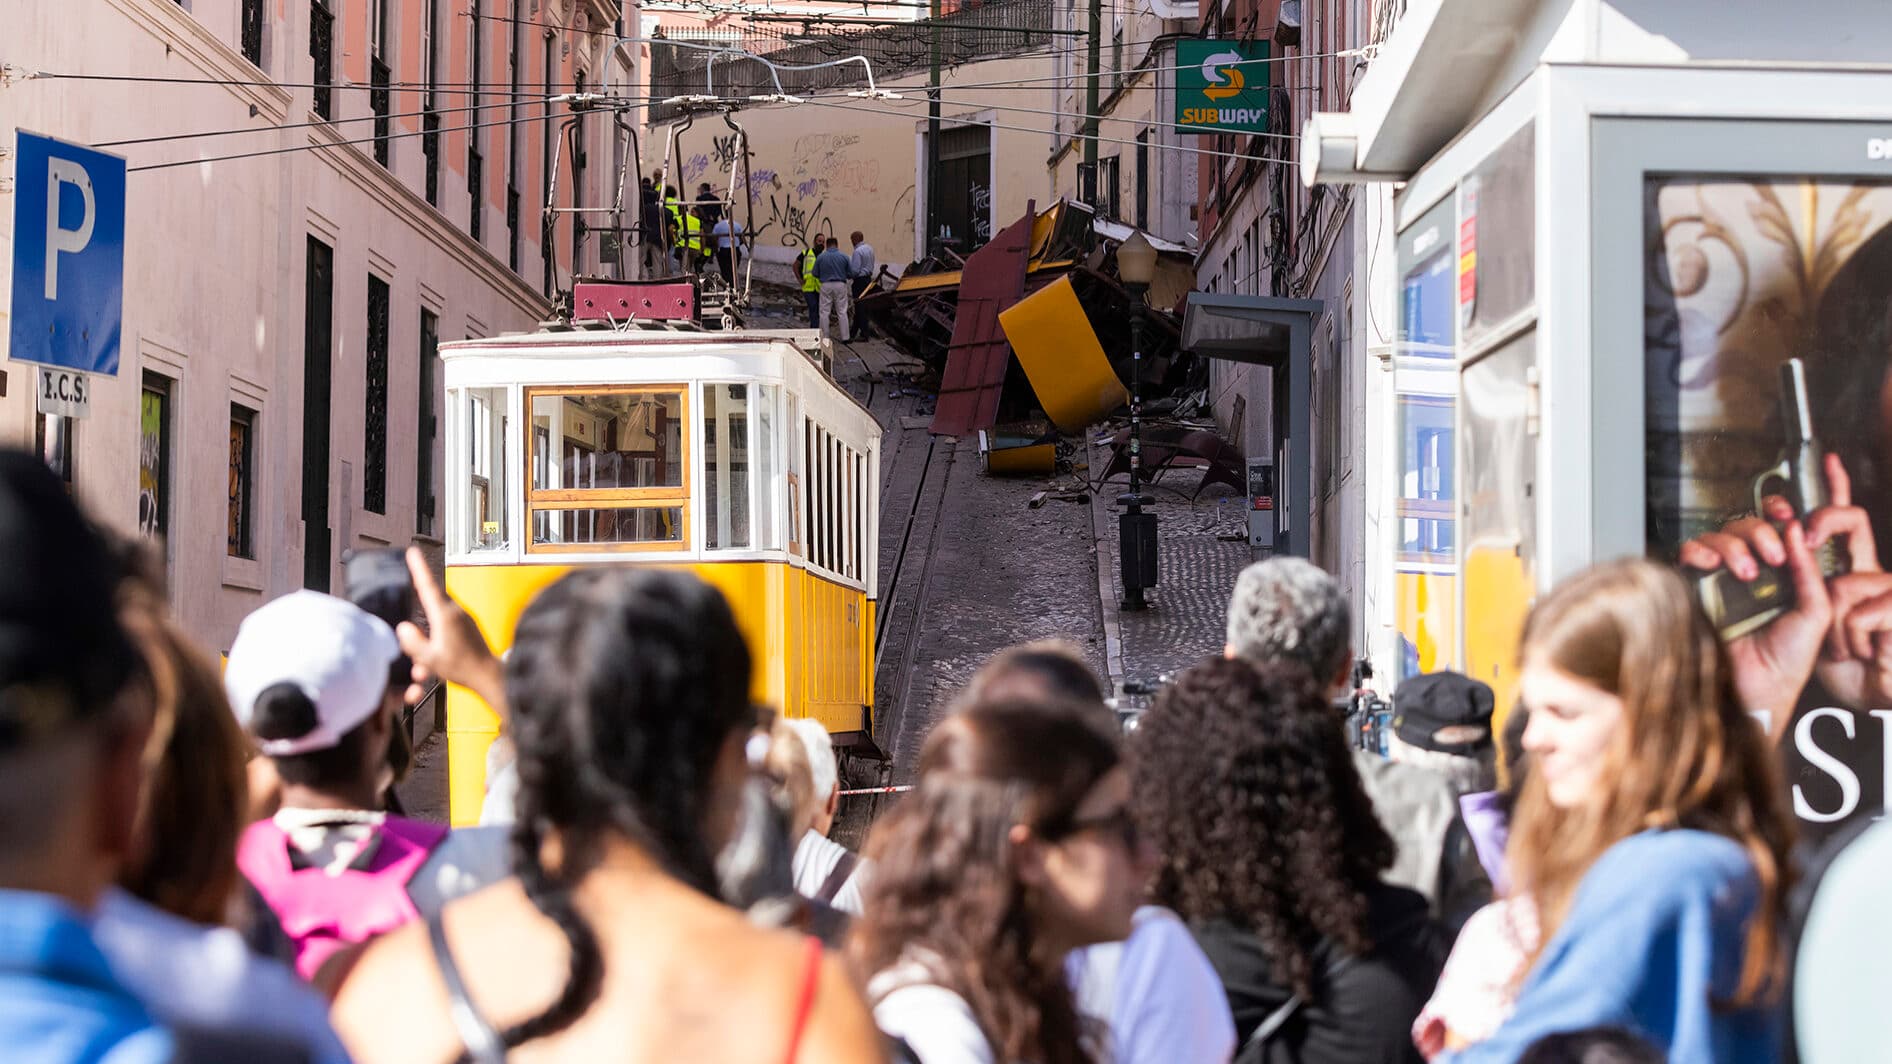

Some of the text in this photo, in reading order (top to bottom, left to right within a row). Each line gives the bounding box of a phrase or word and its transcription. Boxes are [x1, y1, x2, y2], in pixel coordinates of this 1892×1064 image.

[1180, 107, 1262, 124] SUBWAY
[45, 156, 96, 301] P
[44, 371, 88, 404] I.C.S.
